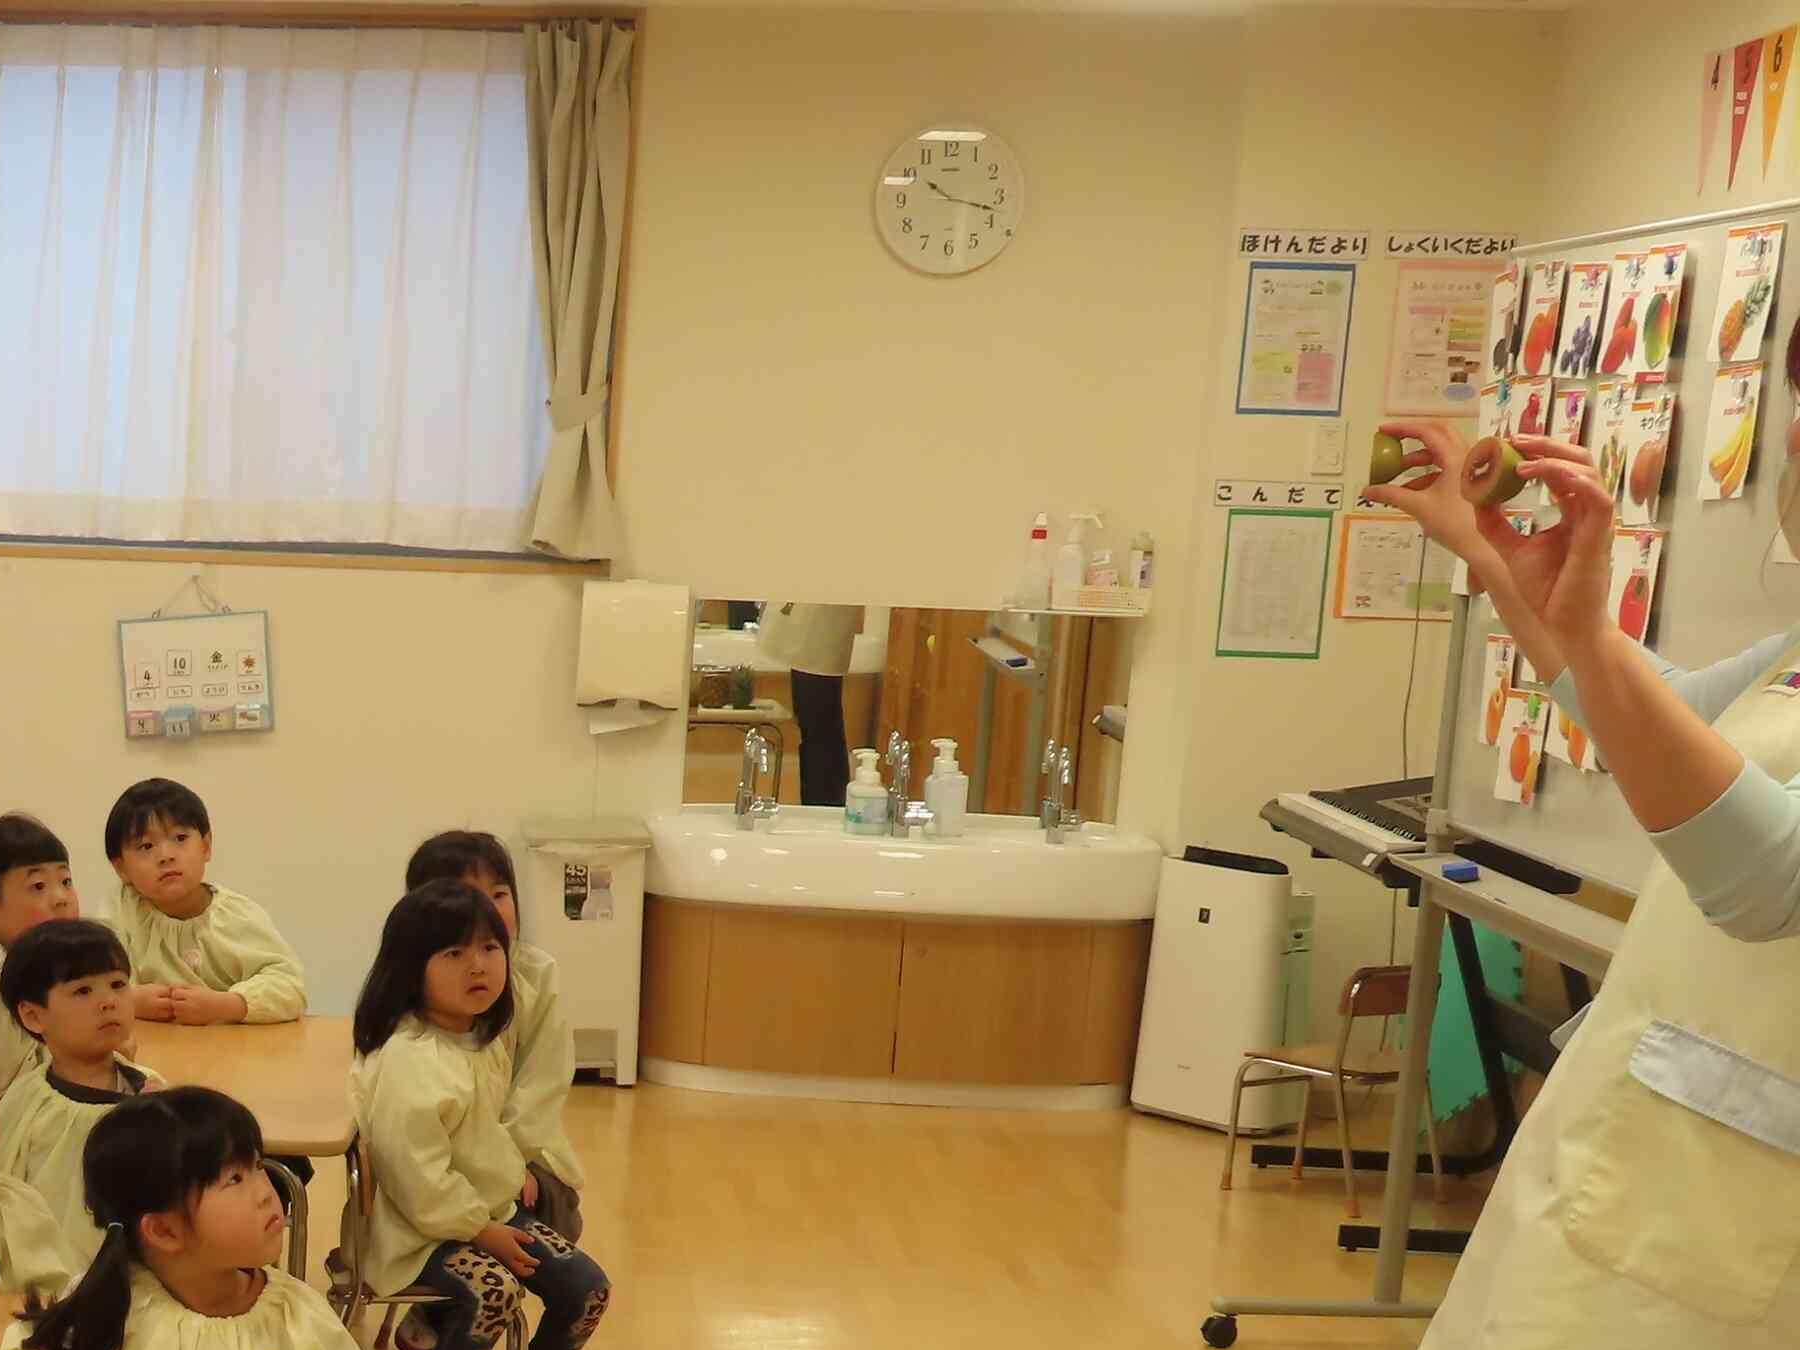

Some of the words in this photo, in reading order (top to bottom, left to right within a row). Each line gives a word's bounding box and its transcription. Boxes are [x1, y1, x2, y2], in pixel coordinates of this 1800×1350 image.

[920, 148, 932, 165] 11
[943, 141, 959, 158] 12
[973, 146, 978, 163] 1
[988, 163, 998, 180] 2
[896, 192, 906, 208] 9
[993, 187, 1005, 205] 3
[902, 217, 913, 234] 8
[920, 235, 929, 251] 7
[943, 240, 954, 256] 6
[968, 233, 979, 249] 5
[1241, 234, 1368, 254] ほけんだより
[1388, 236, 1515, 255] しょくいくだより
[1216, 484, 1341, 505] こんだて
[173, 657, 186, 669] 10
[210, 651, 223, 663] 金
